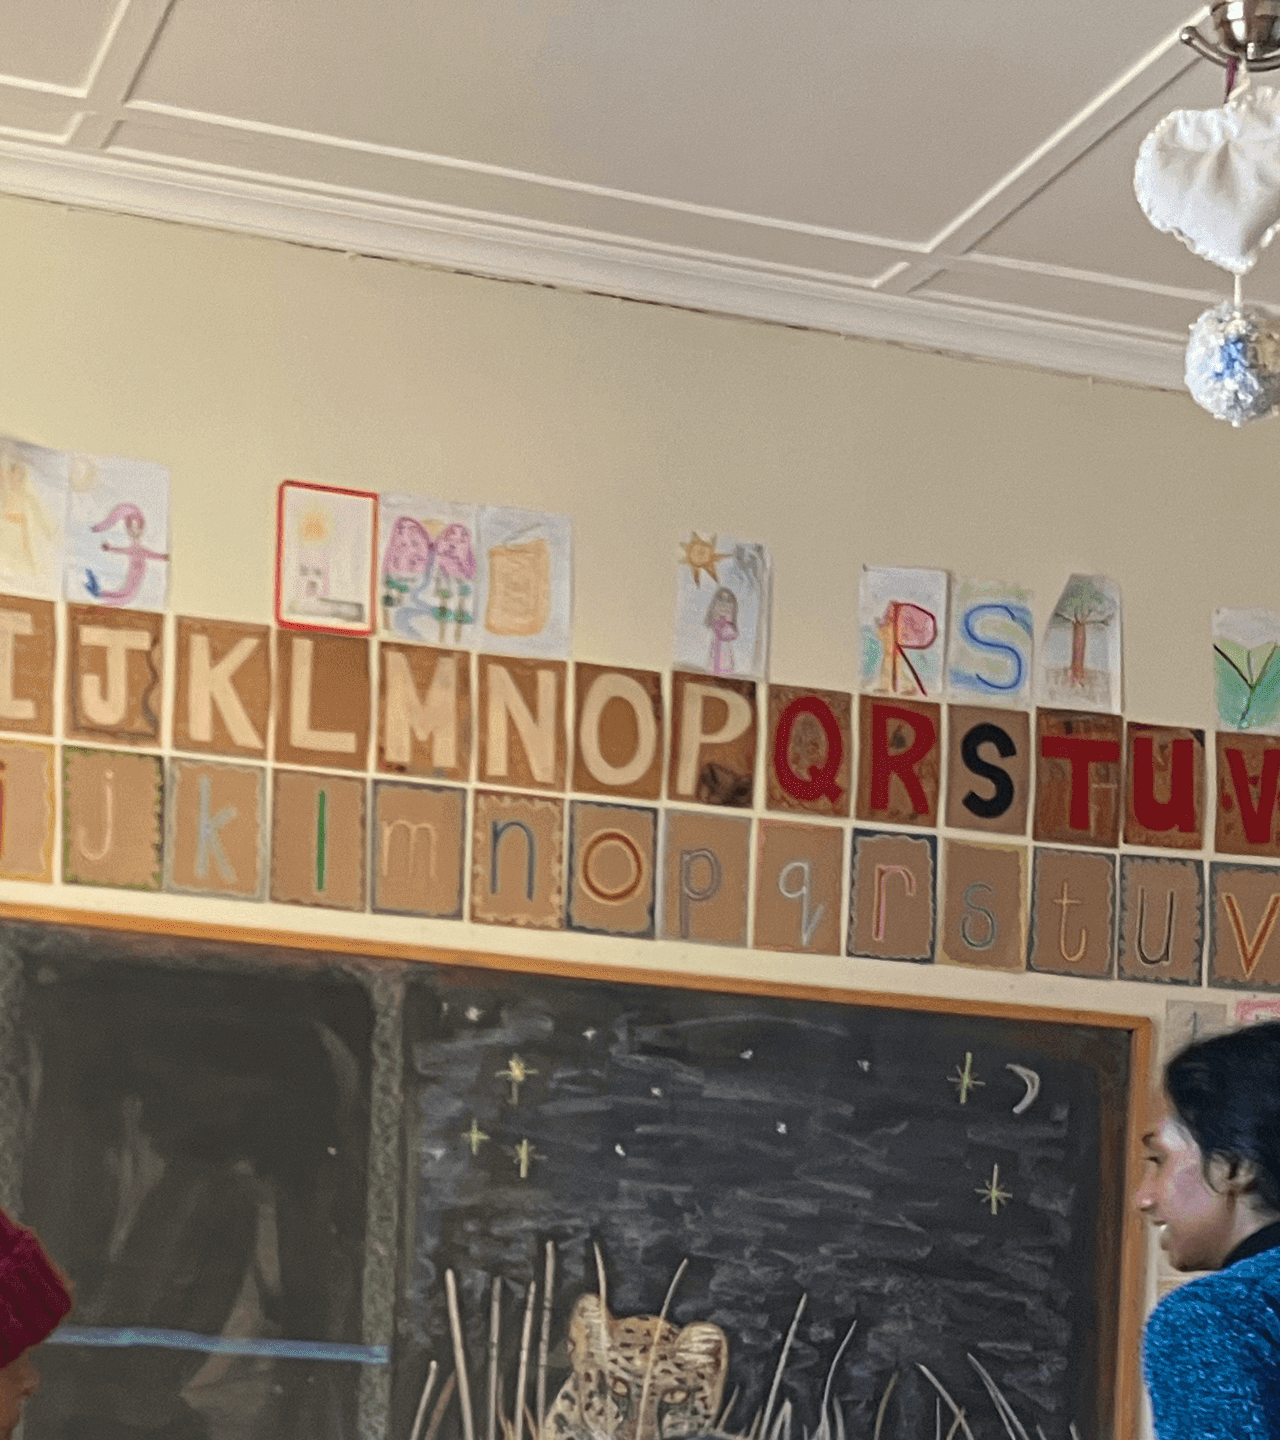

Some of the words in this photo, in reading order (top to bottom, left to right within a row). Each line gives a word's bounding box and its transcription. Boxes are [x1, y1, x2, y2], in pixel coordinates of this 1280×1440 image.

[893, 601, 937, 696] R
[964, 605, 1021, 690] S
[79, 626, 150, 726] J
[188, 636, 265, 748] K
[290, 639, 357, 753] L
[385, 651, 459, 768] M
[487, 666, 556, 782] N
[580, 672, 657, 785] O
[675, 680, 752, 794] P
[773, 697, 843, 803] Q
[870, 705, 935, 814] R
[961, 722, 1016, 817] S
[1041, 736, 1119, 829] T
[1132, 738, 1195, 833] U
[75, 770, 113, 862] j
[195, 776, 238, 882] k
[380, 817, 438, 879] m
[490, 815, 537, 901] n
[777, 861, 824, 946] q
[872, 864, 916, 941] r
[1054, 881, 1087, 962] t
